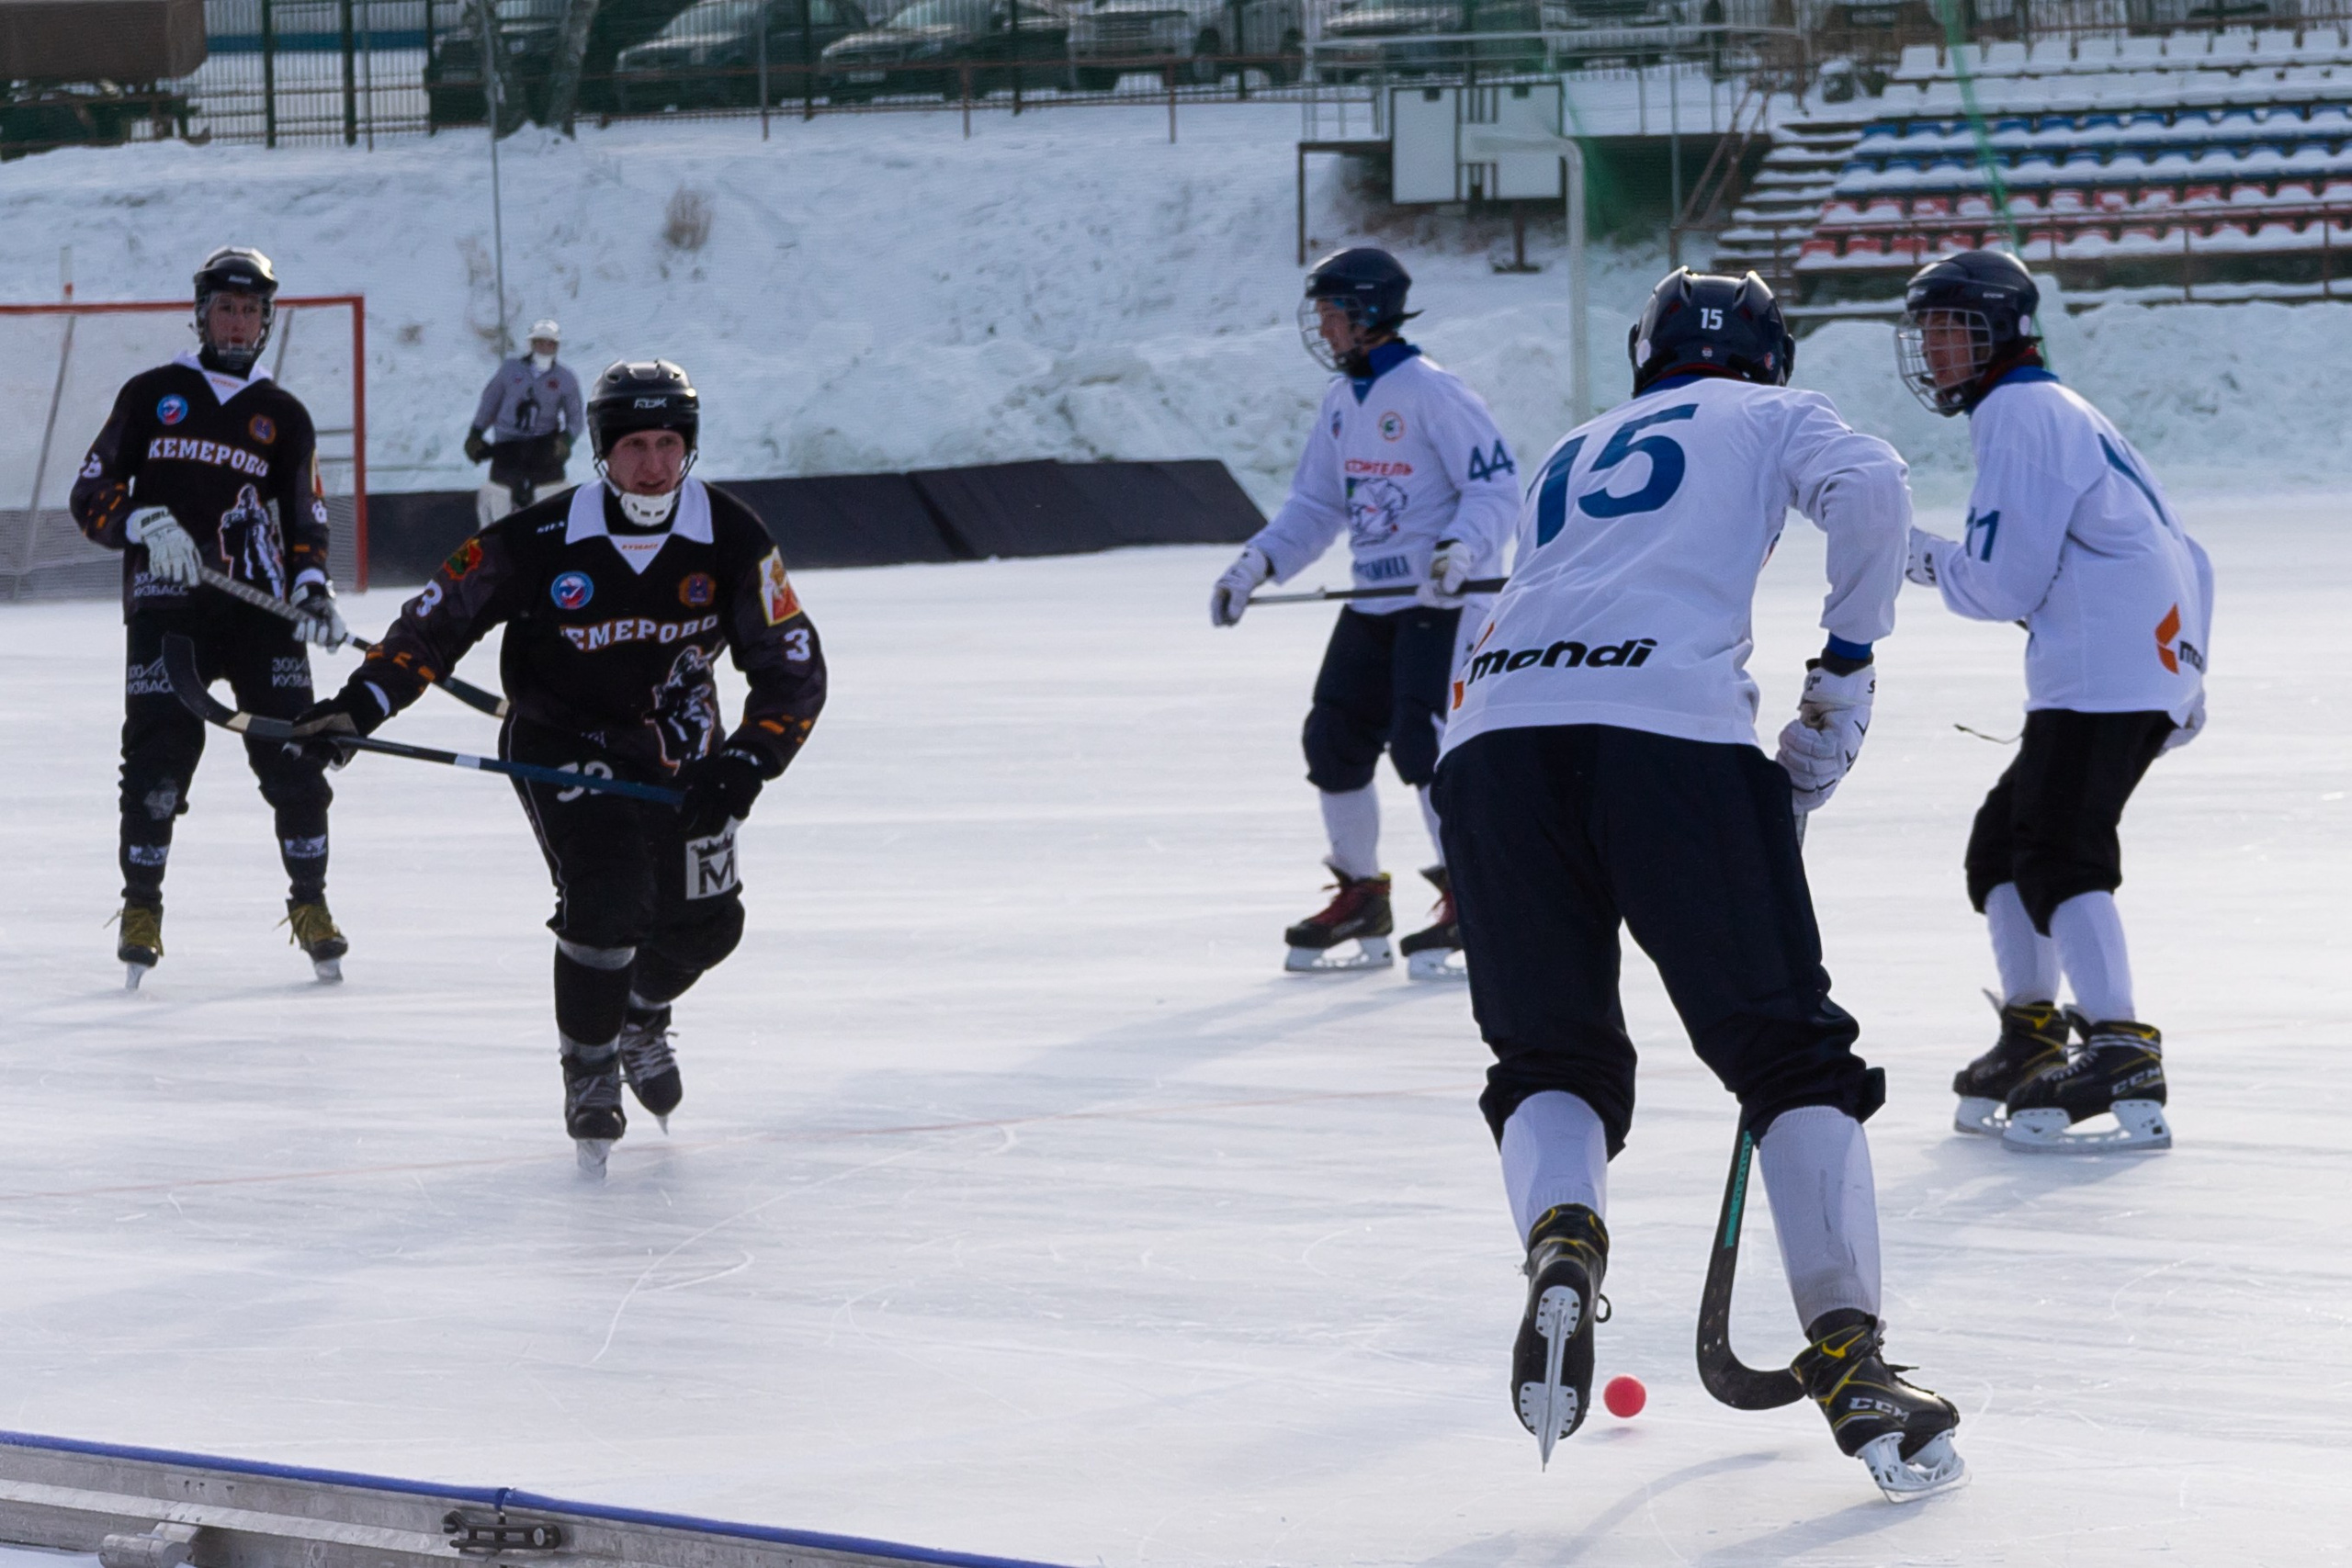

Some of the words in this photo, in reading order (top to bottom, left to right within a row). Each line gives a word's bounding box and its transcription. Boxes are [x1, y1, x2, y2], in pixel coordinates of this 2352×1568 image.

[1700, 307, 1724, 331] 15
[1468, 439, 1515, 483] 44
[1525, 403, 1699, 549] 15
[415, 579, 444, 618] 3
[560, 614, 719, 652] ЕМЕРОВО
[784, 628, 812, 661] 3
[1466, 638, 1657, 686] mondi
[1849, 1397, 1911, 1423] CCM
